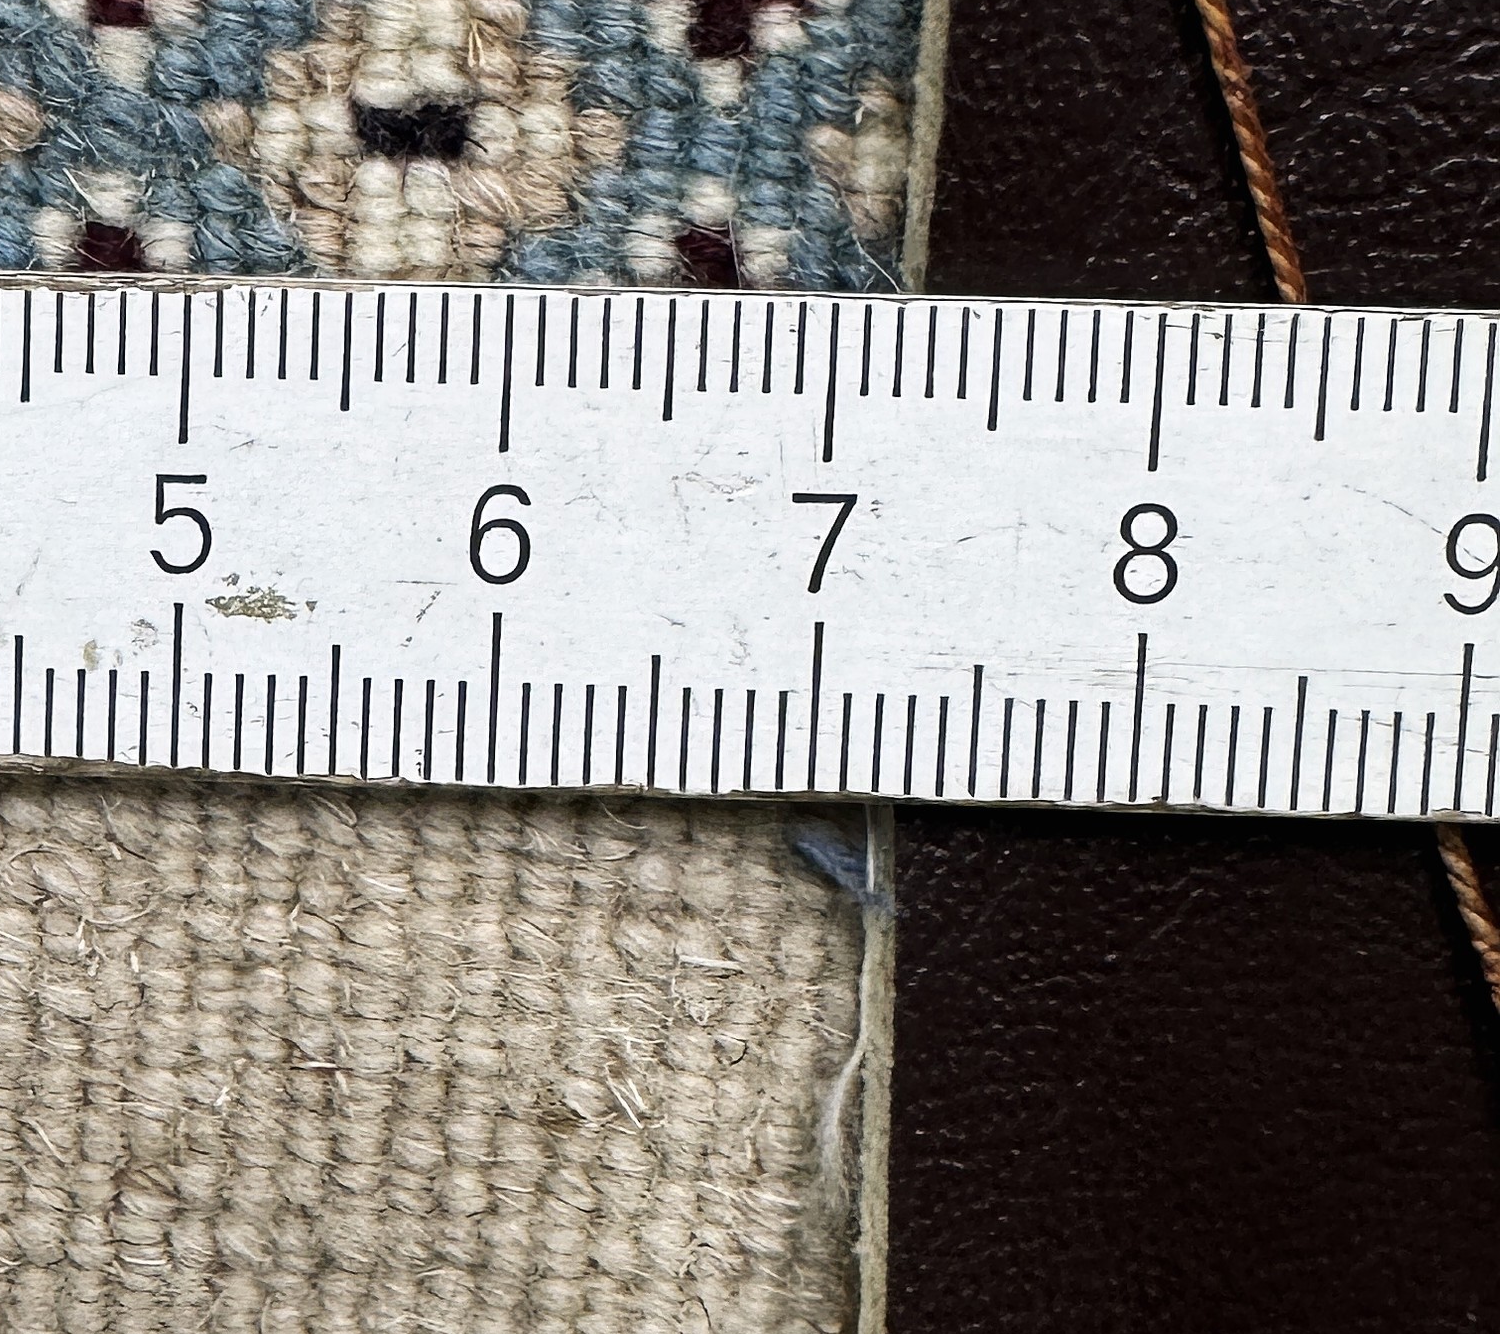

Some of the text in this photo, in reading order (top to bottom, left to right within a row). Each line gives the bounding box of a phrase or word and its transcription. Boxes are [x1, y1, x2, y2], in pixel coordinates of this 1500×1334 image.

[149, 473, 213, 575] 5
[469, 483, 532, 585] 6
[791, 492, 858, 594] 7
[1112, 502, 1179, 605] 8
[1443, 513, 1500, 616] 9
